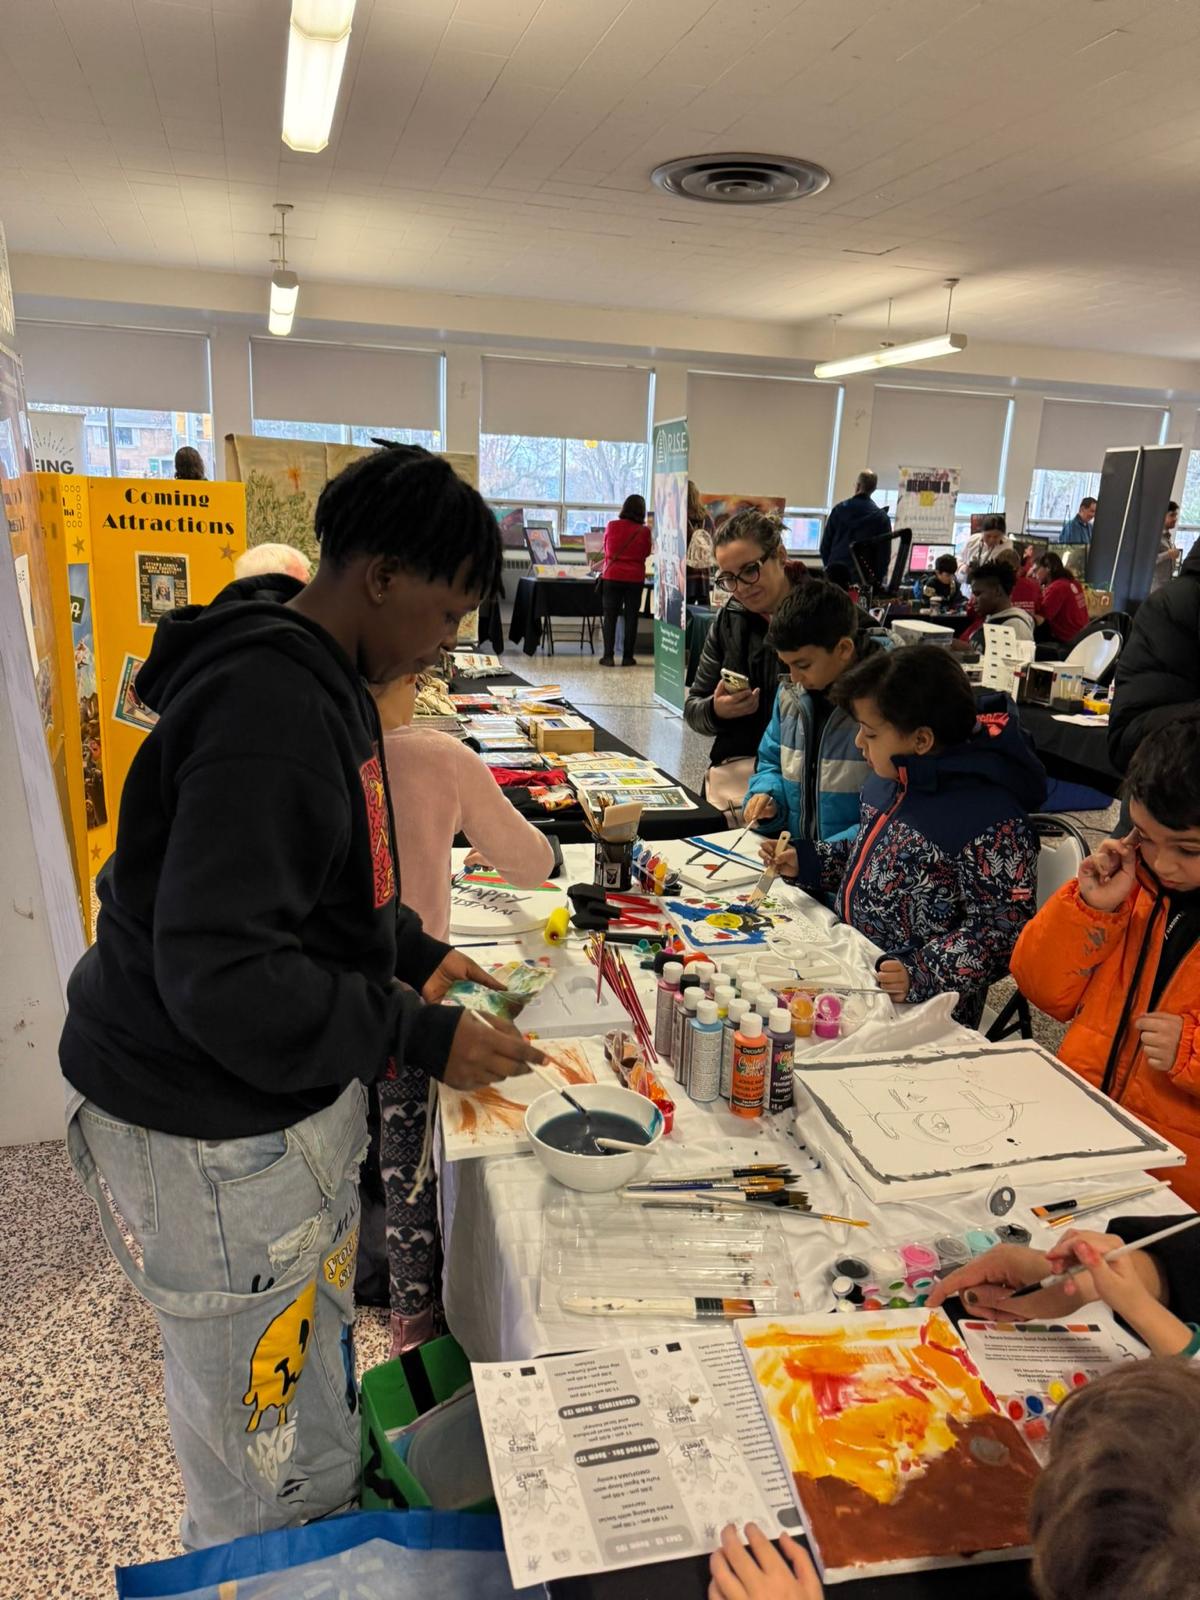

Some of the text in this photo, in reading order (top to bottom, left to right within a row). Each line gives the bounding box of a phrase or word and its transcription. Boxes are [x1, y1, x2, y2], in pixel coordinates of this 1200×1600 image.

[125, 488, 210, 508] Coming
[102, 513, 235, 535] Attractions
[451, 882, 533, 903] HAPPY
